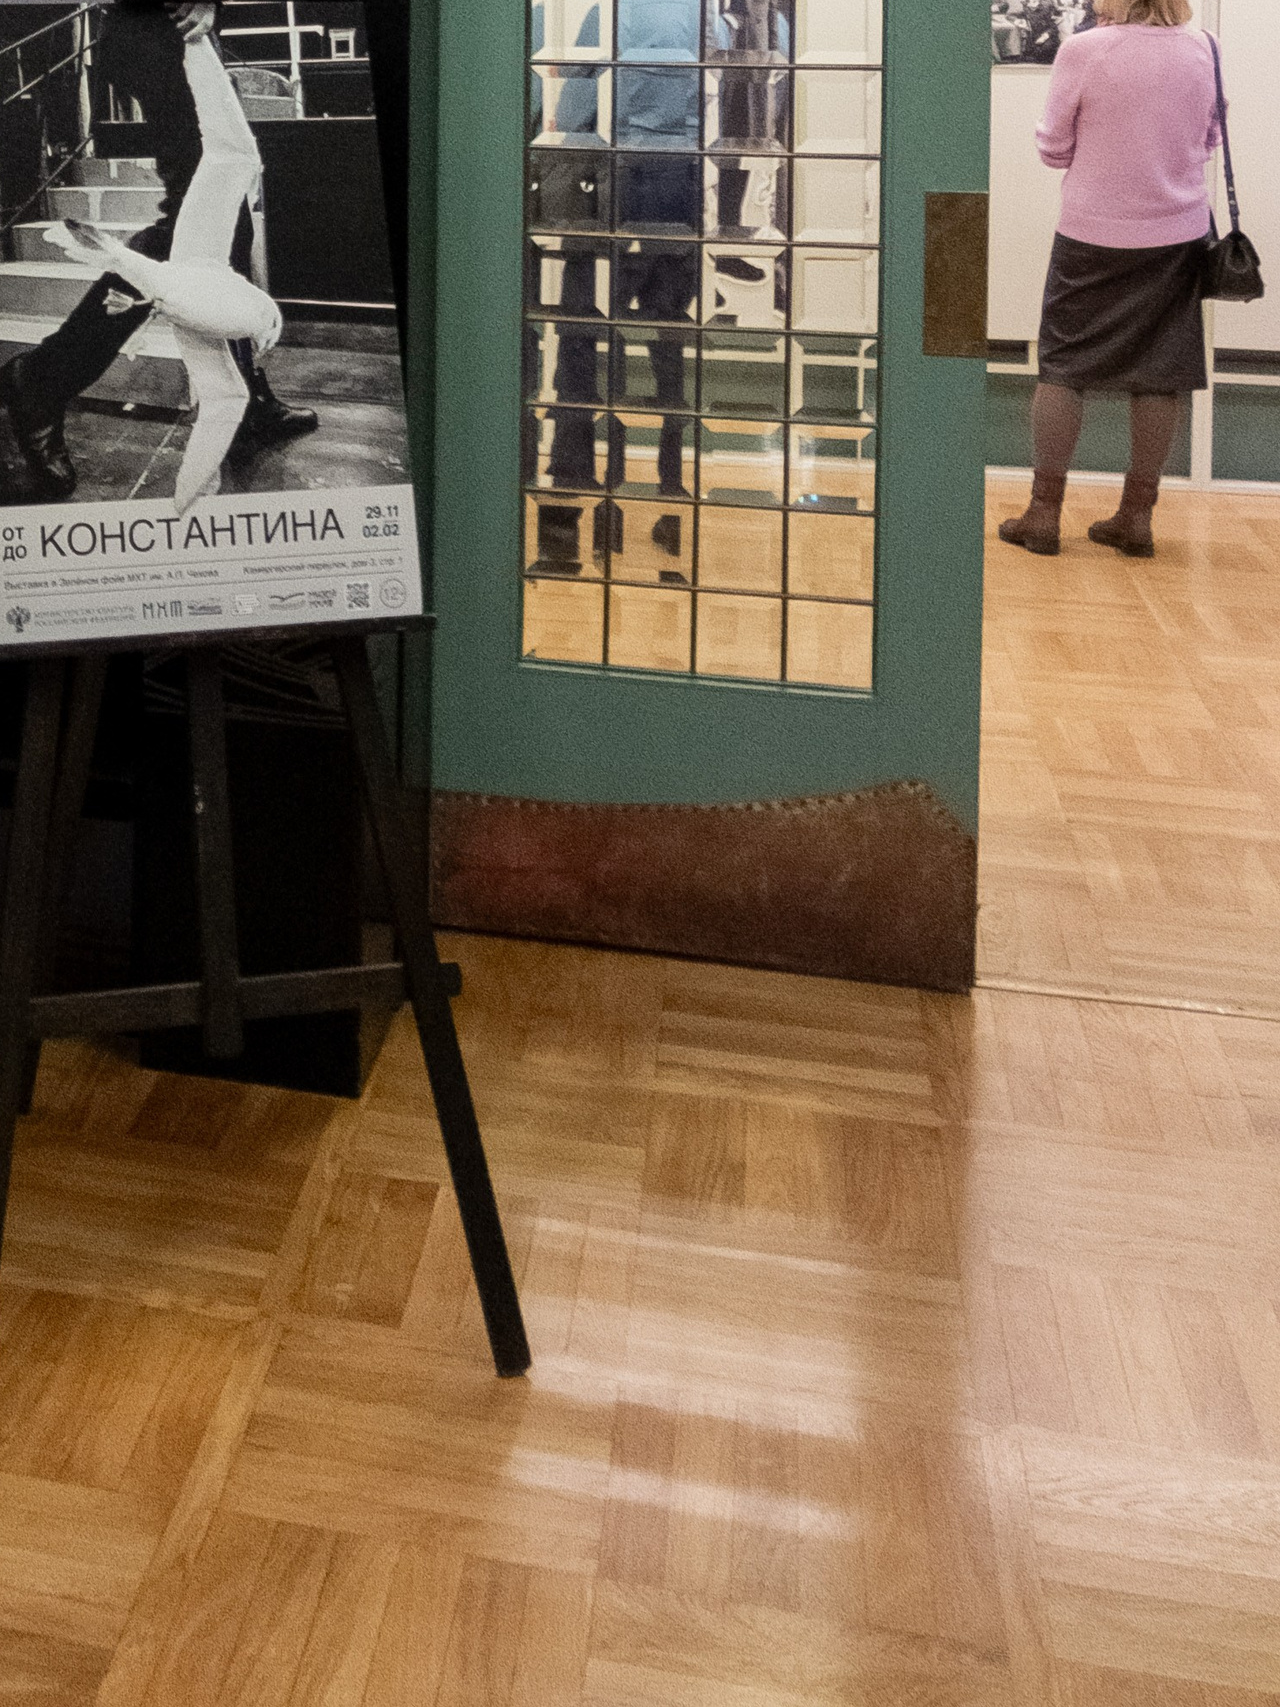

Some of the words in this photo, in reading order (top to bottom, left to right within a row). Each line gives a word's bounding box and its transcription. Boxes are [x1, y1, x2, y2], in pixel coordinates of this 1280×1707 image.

[365, 505, 400, 520] 29.11
[2, 525, 24, 542] ОТ
[40, 508, 345, 559] КОНСТАНТИНА
[363, 523, 401, 539] 02.02
[2, 544, 27, 562] ДО
